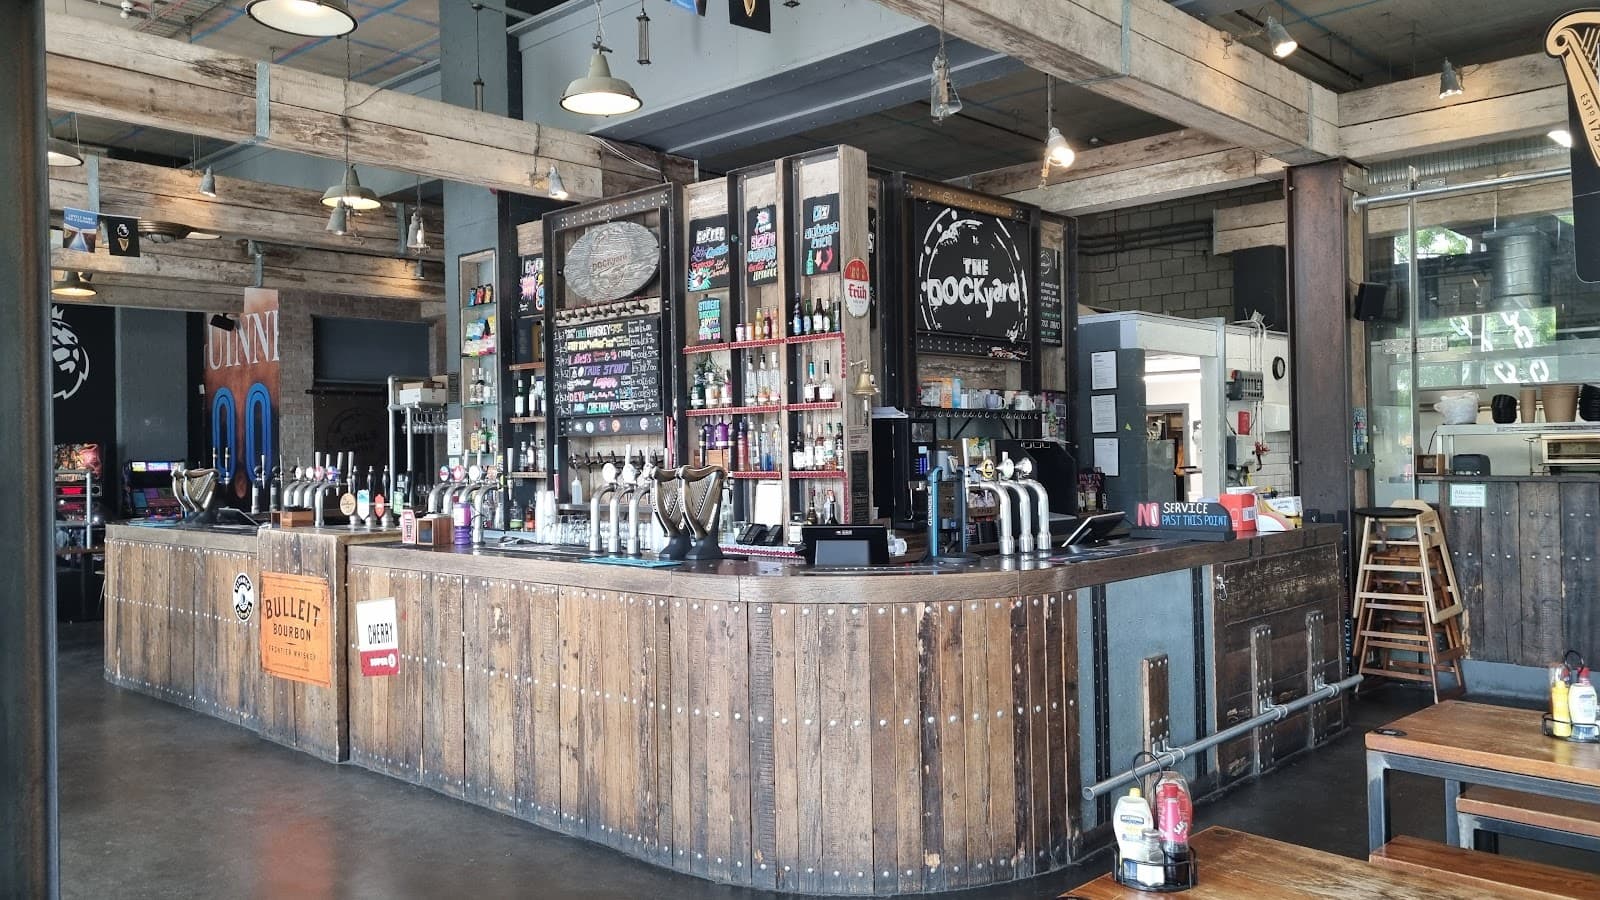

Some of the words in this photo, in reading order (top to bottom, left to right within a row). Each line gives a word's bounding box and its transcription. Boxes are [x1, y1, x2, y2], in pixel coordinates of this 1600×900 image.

[1588, 118, 1600, 149] 175
[696, 227, 725, 244] COFFEE
[962, 258, 989, 276] THE
[603, 363, 629, 376] STOUT
[1137, 502, 1159, 528] NO
[1162, 502, 1208, 515] SERVICE
[1162, 515, 1181, 527] PAST
[1183, 514, 1203, 527] THIS
[1204, 514, 1228, 527] POINT
[265, 596, 321, 628] BULLEIT
[273, 622, 311, 642] BOURBON
[367, 622, 393, 646] CHERRY
[268, 644, 293, 656] FRONTIER
[293, 650, 317, 662] WHISKEY
